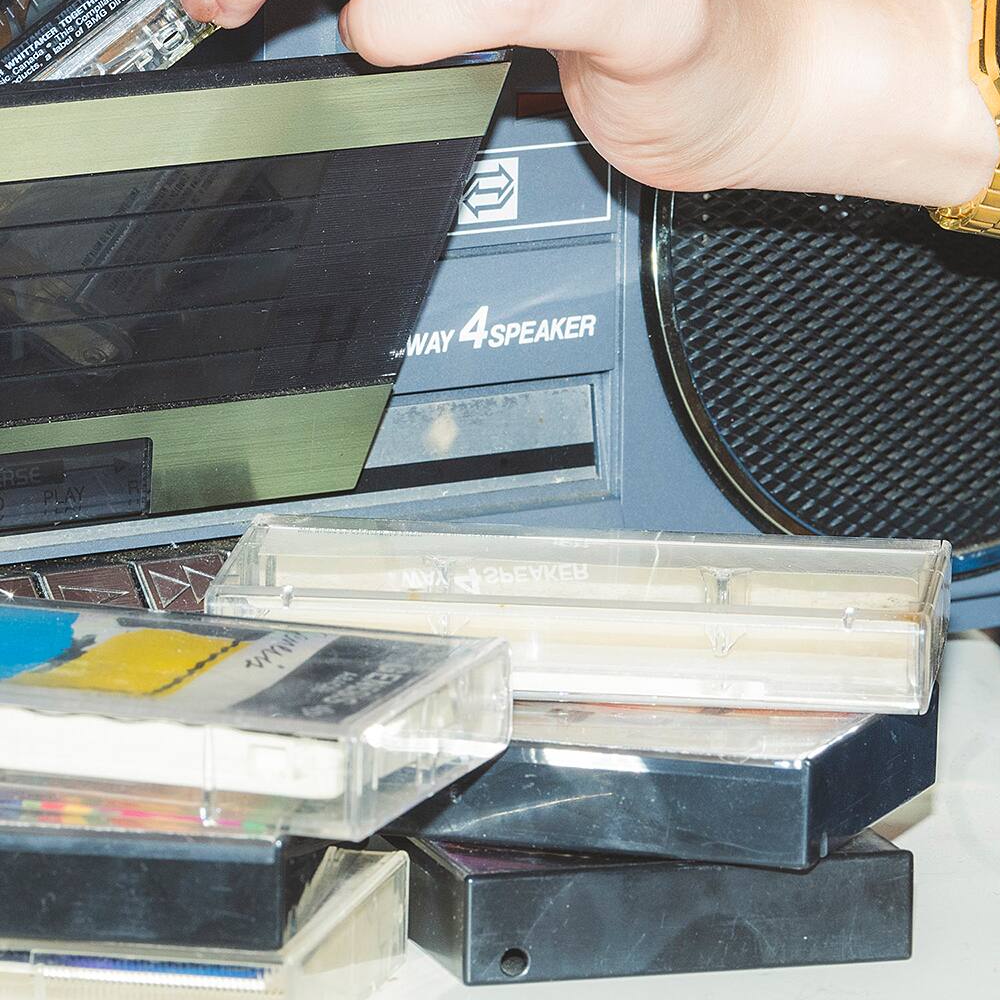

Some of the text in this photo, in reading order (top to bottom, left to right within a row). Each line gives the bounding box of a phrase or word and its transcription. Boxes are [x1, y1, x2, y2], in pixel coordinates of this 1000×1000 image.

[5, 25, 60, 70] WHITTAKER
[12, 49, 45, 75] Canada
[55, 23, 74, 43] This
[52, 36, 74, 56] label
[75, 27, 85, 38] of
[85, 9, 108, 30] BMG
